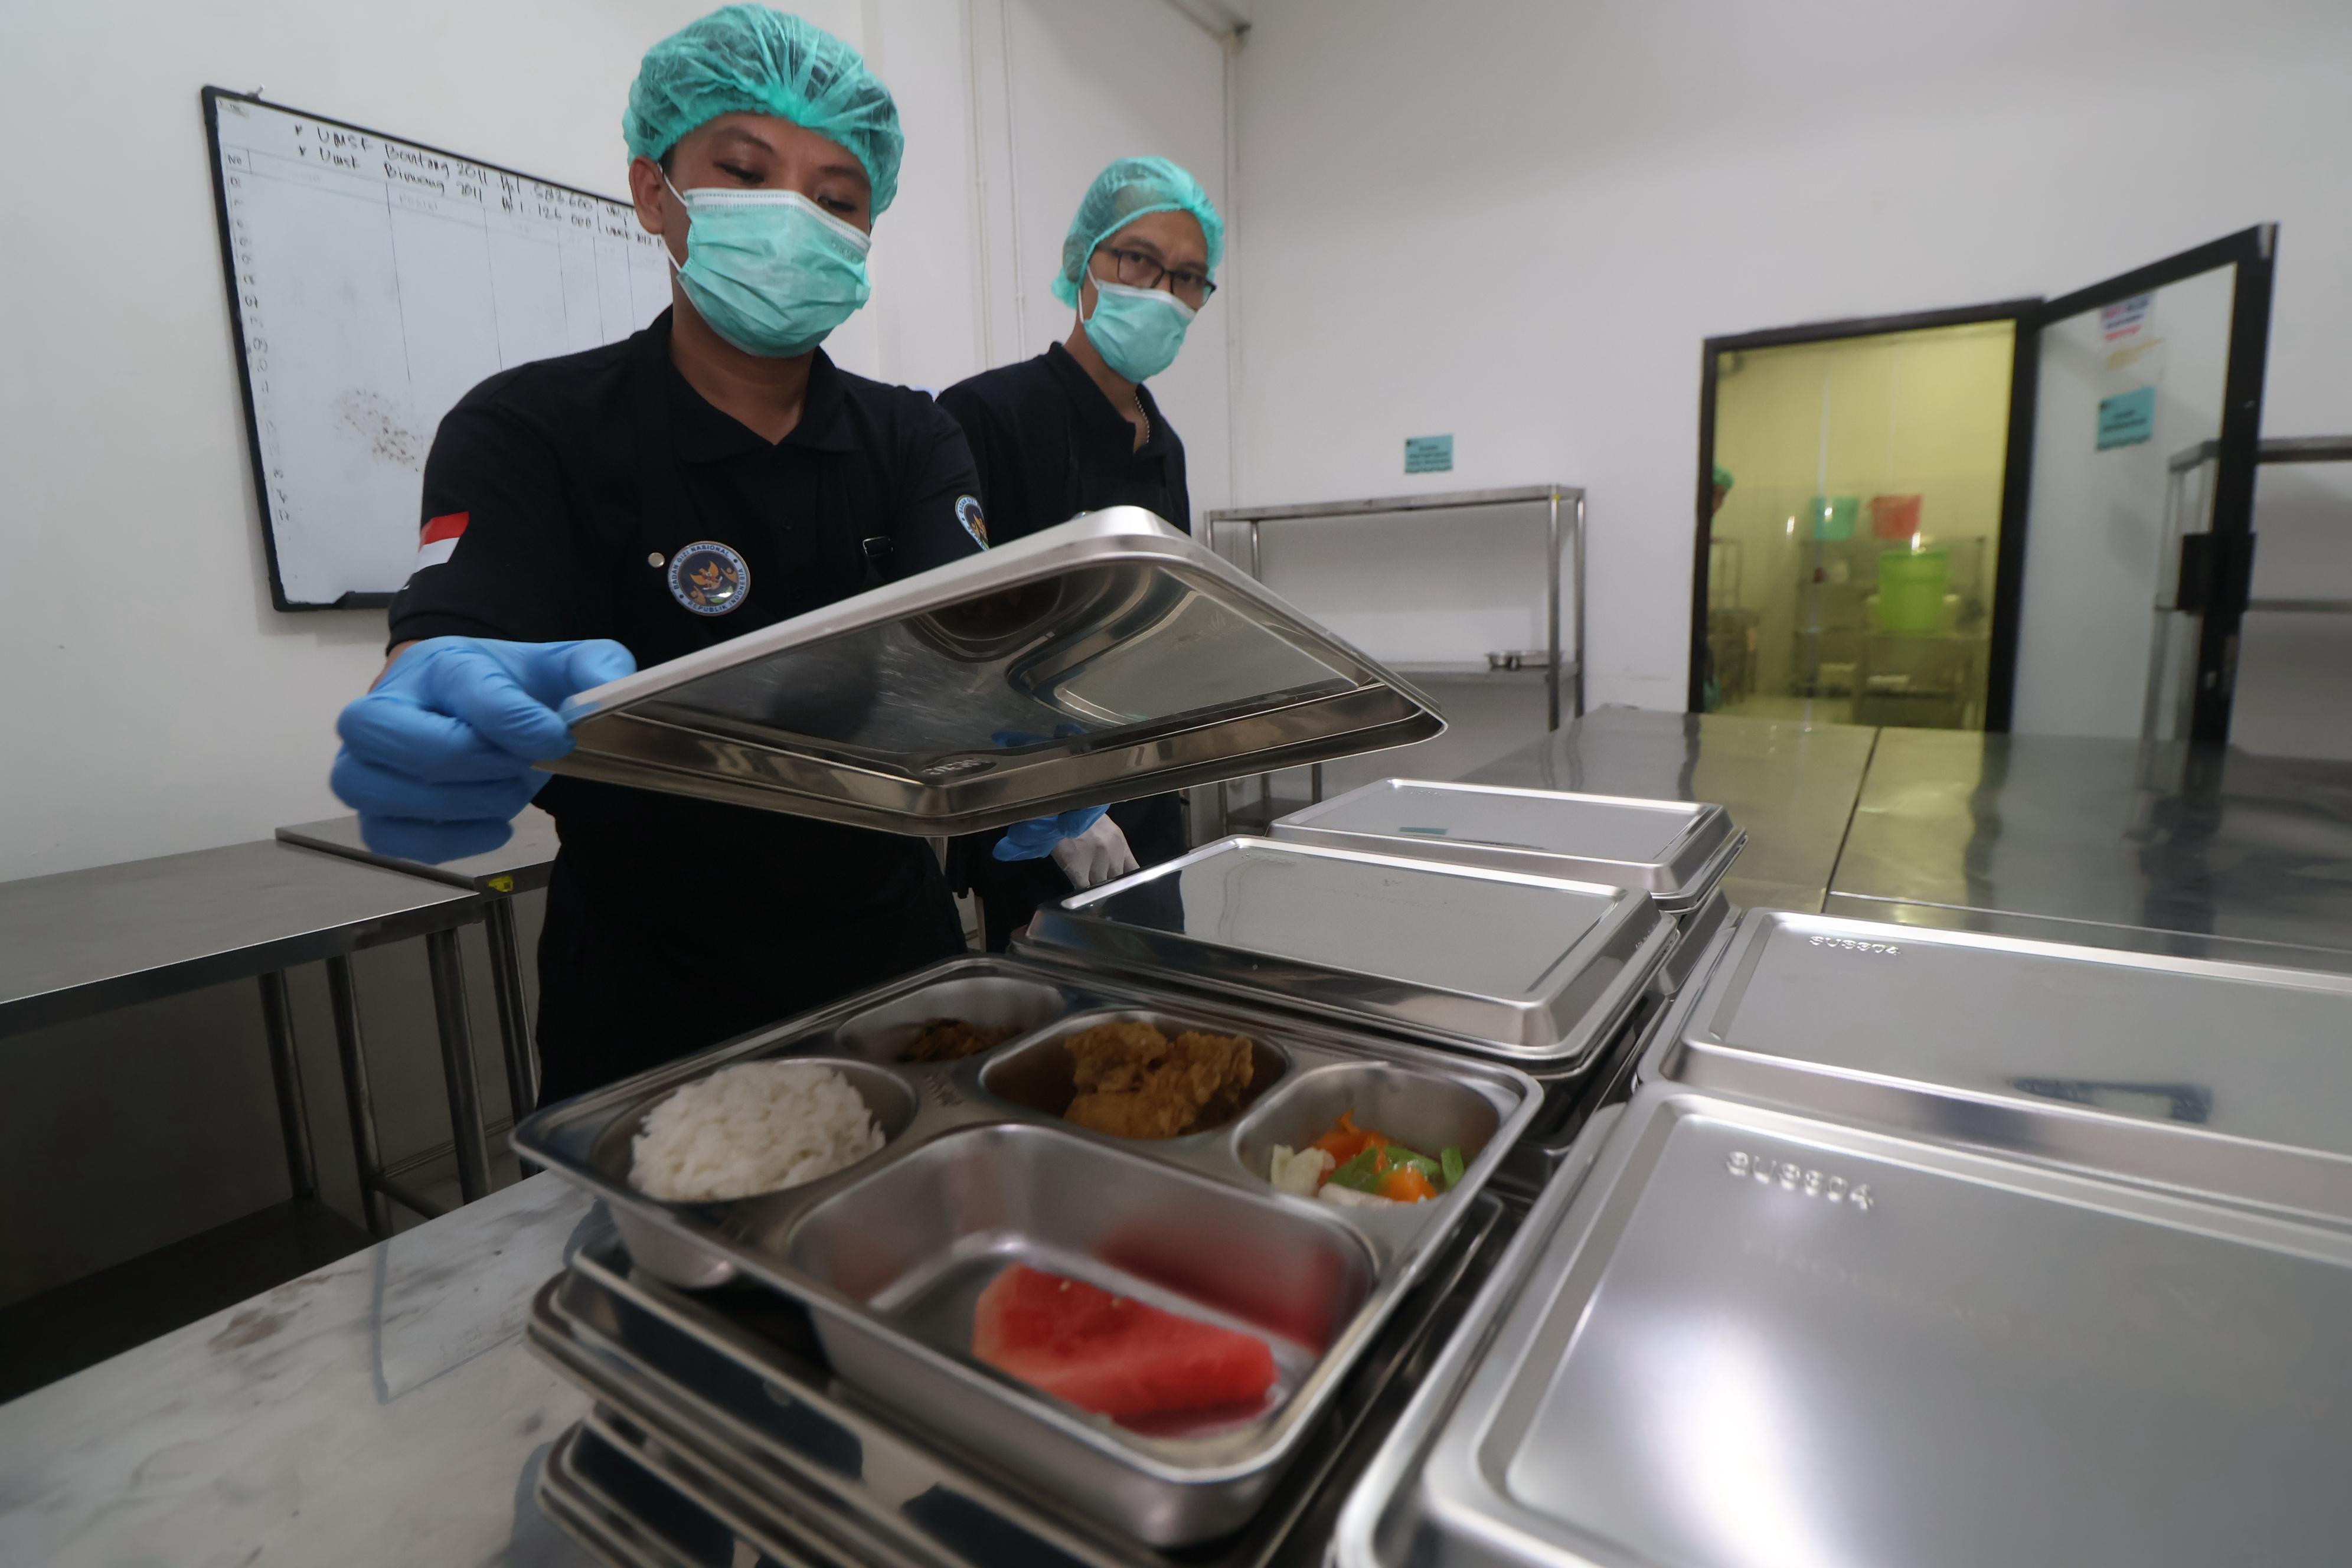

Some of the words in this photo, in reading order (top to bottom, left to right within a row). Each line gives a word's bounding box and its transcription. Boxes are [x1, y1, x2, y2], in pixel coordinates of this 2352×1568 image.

[677, 551, 690, 563] GIZI
[691, 545, 730, 557] NASIONAL
[687, 601, 728, 612] REPUBLIK
[730, 567, 746, 607] INDONESIA
[1808, 935, 1902, 956] SUS304
[1724, 1150, 1874, 1211] SUS304
